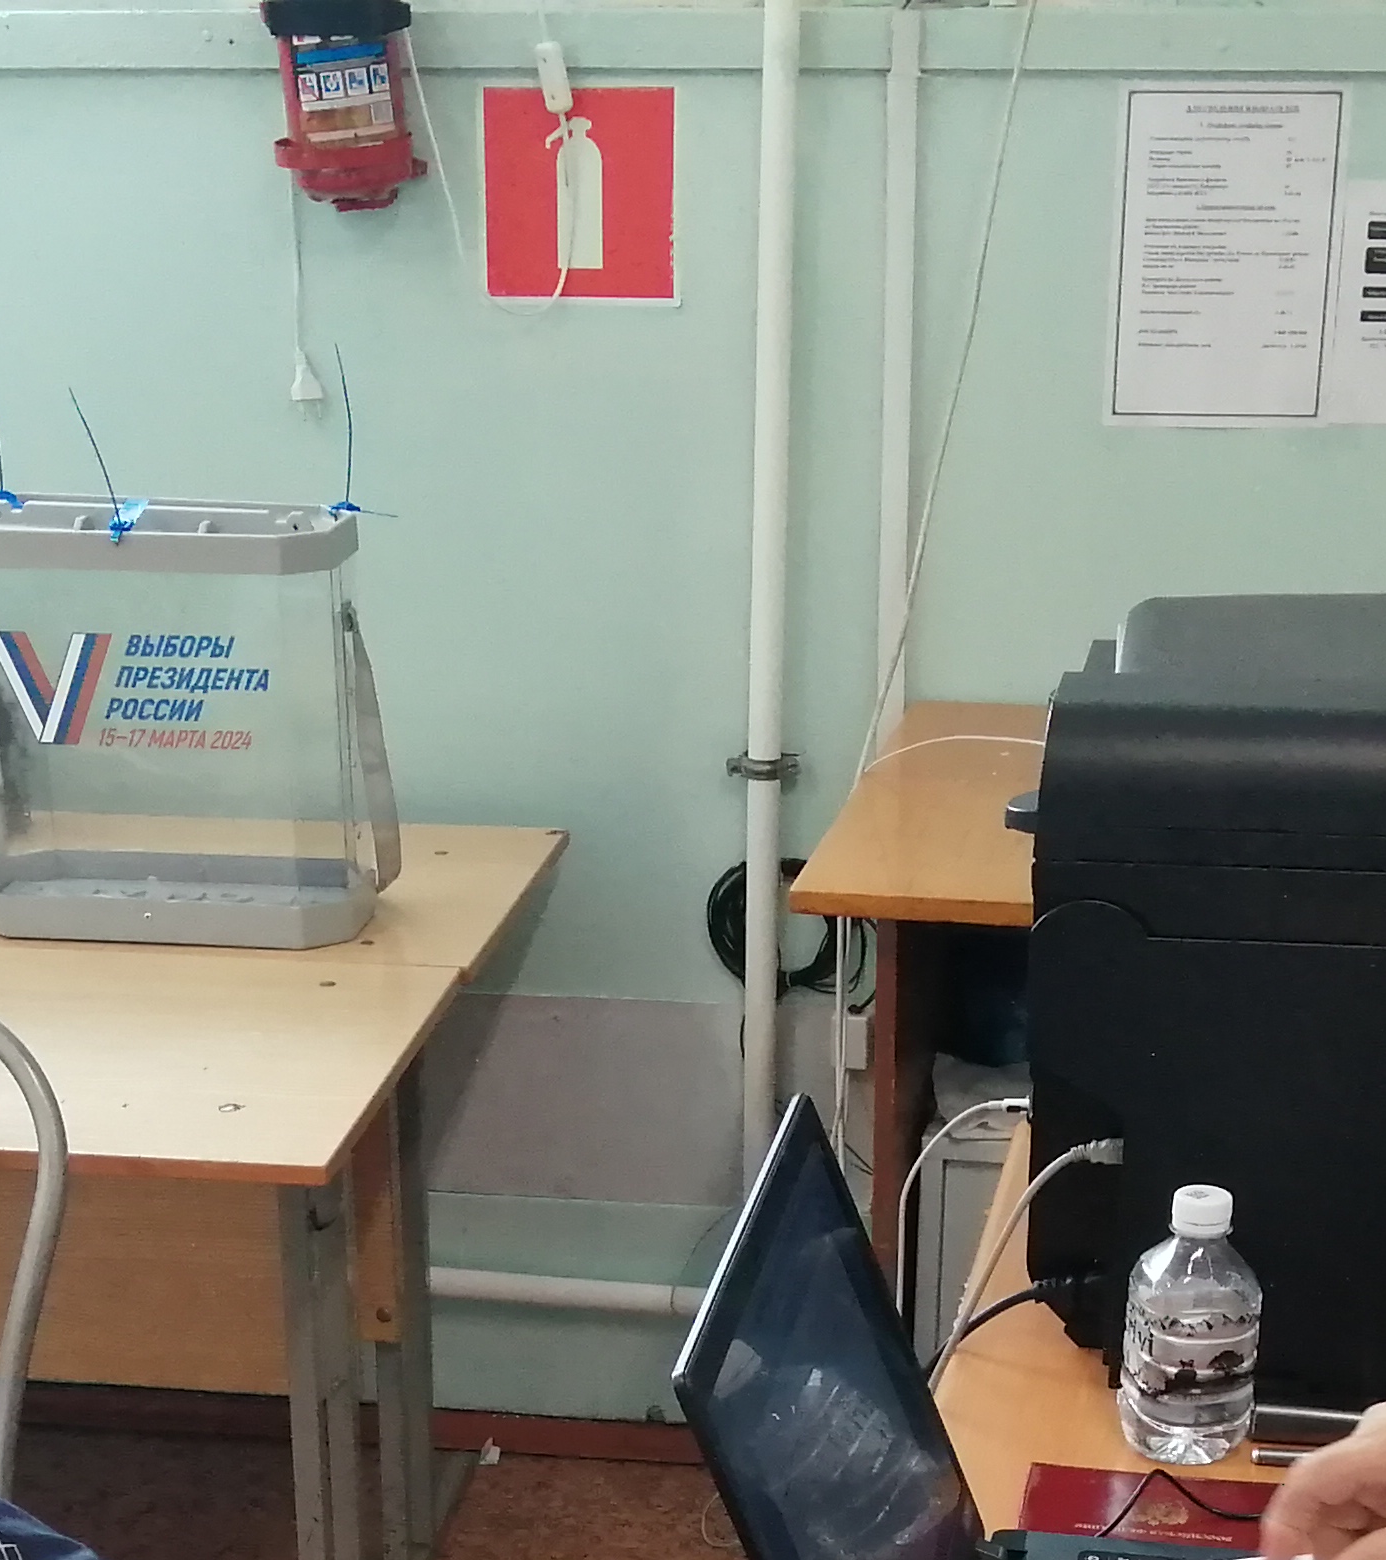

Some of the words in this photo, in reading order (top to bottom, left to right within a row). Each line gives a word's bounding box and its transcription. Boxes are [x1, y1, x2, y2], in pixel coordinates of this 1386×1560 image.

[124, 634, 235, 659] ВЫБОРЫ
[114, 665, 270, 694] ПРЕЗИДЕНТА
[104, 697, 204, 722] РОССИИ
[147, 729, 207, 750] МАРТА
[210, 730, 253, 751] 2024
